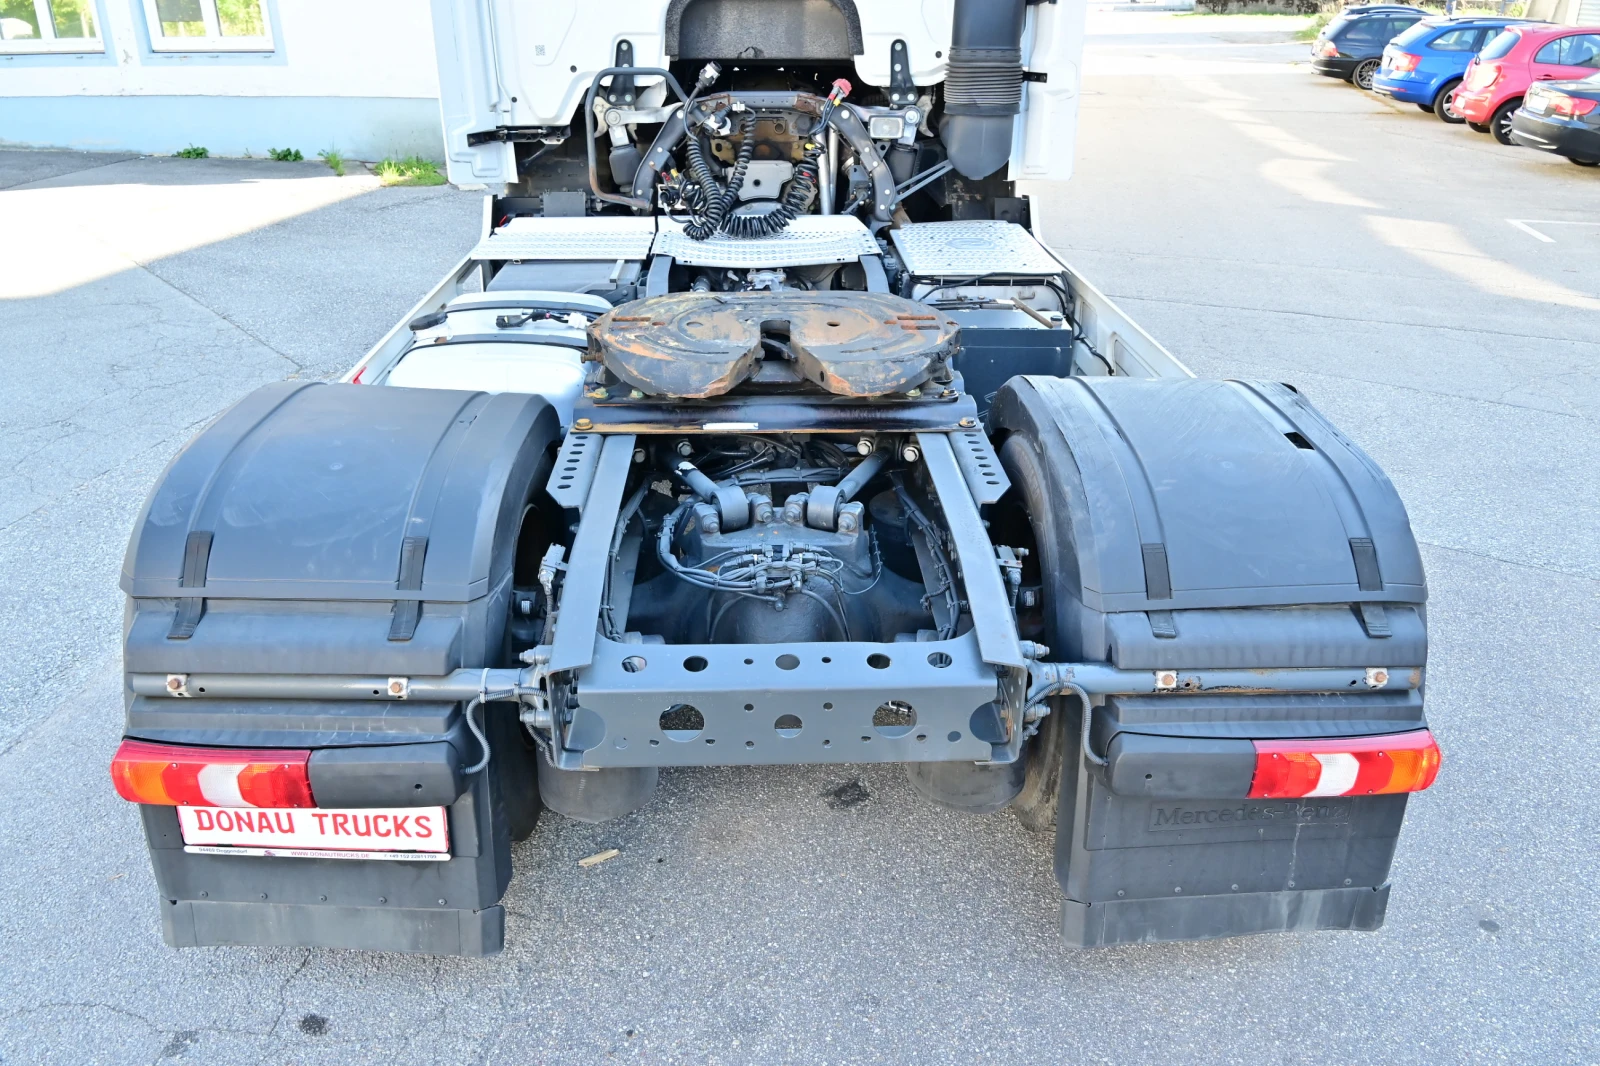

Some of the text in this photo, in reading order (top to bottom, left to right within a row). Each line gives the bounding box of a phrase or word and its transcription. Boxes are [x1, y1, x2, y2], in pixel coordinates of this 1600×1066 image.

[193, 809, 433, 838] DONAU TRUCKS
[1153, 802, 1348, 826] Mercedes-Benz
